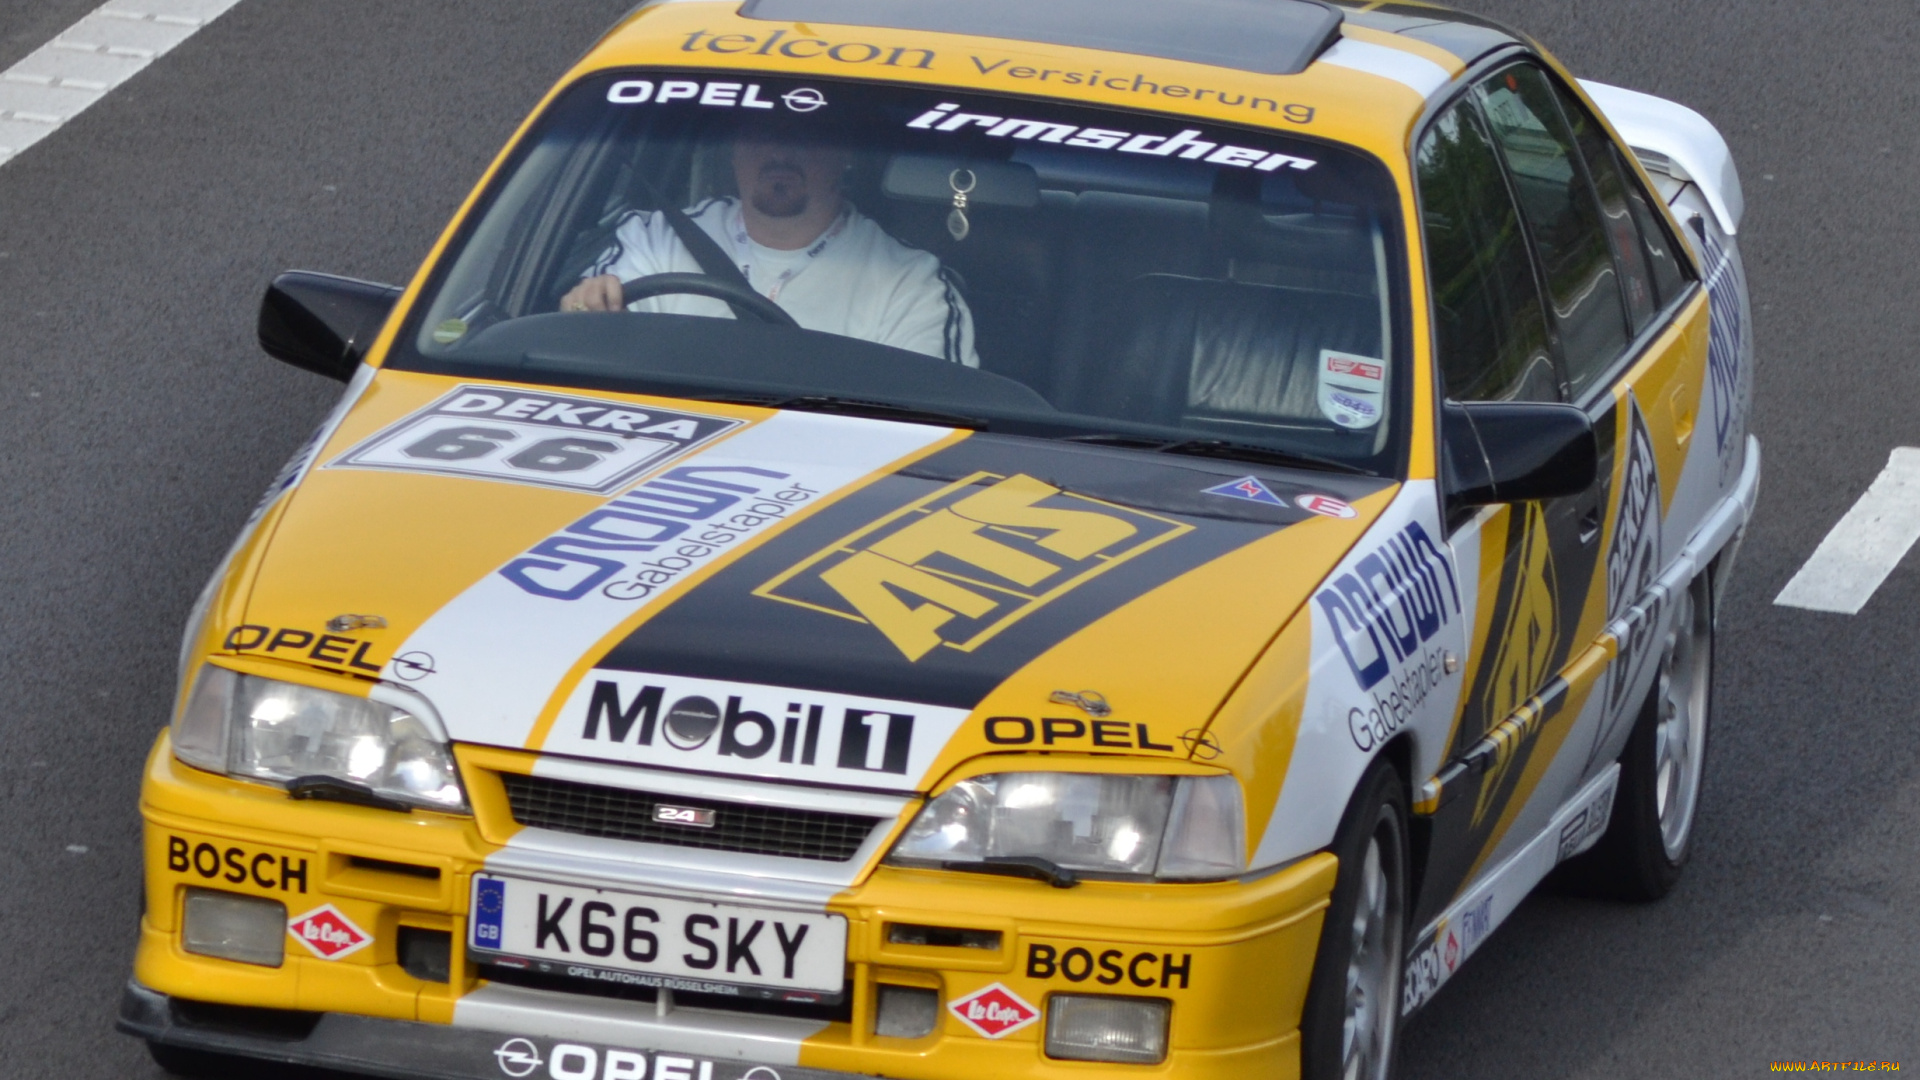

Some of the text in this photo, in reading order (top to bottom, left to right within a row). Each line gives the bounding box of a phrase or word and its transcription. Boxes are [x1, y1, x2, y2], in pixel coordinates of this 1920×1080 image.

[606, 79, 774, 109] OPEL
[680, 28, 1315, 126] telcon Versicherung
[907, 102, 1317, 172] irmscher
[438, 393, 698, 440] DEKRA
[400, 425, 624, 474] 66
[602, 482, 820, 602] Gabelstapler
[819, 473, 1138, 662] ATS
[222, 625, 383, 674] OPEL
[582, 680, 824, 766] Mobil
[1348, 645, 1447, 753] Gabelstapler
[984, 716, 1174, 752] OPEL
[167, 835, 307, 894] BOSCH
[477, 923, 499, 941] GB
[535, 893, 809, 980] K66 SKY
[567, 966, 739, 996] OPEL AUTOHAUS RÜSSELSHEIM
[1026, 943, 1192, 989] BOSCH
